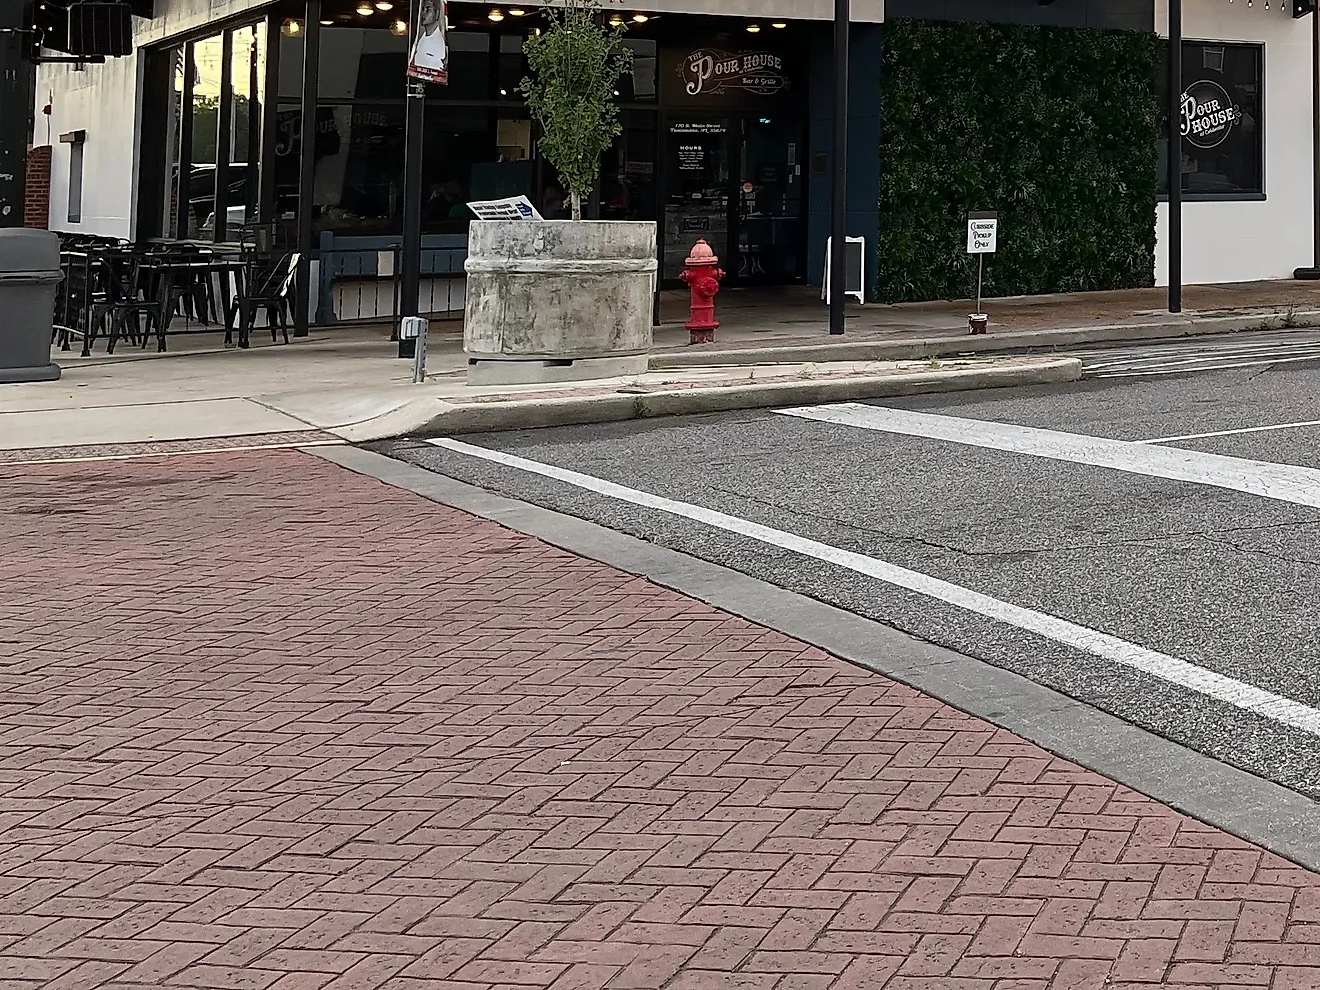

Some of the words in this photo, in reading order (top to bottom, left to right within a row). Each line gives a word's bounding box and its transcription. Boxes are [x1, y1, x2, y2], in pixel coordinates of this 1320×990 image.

[687, 51, 704, 62] THE
[686, 55, 740, 95] POUR
[742, 54, 782, 70] HOUSE
[1180, 96, 1221, 136] POUR
[1191, 107, 1236, 134] HOUSE
